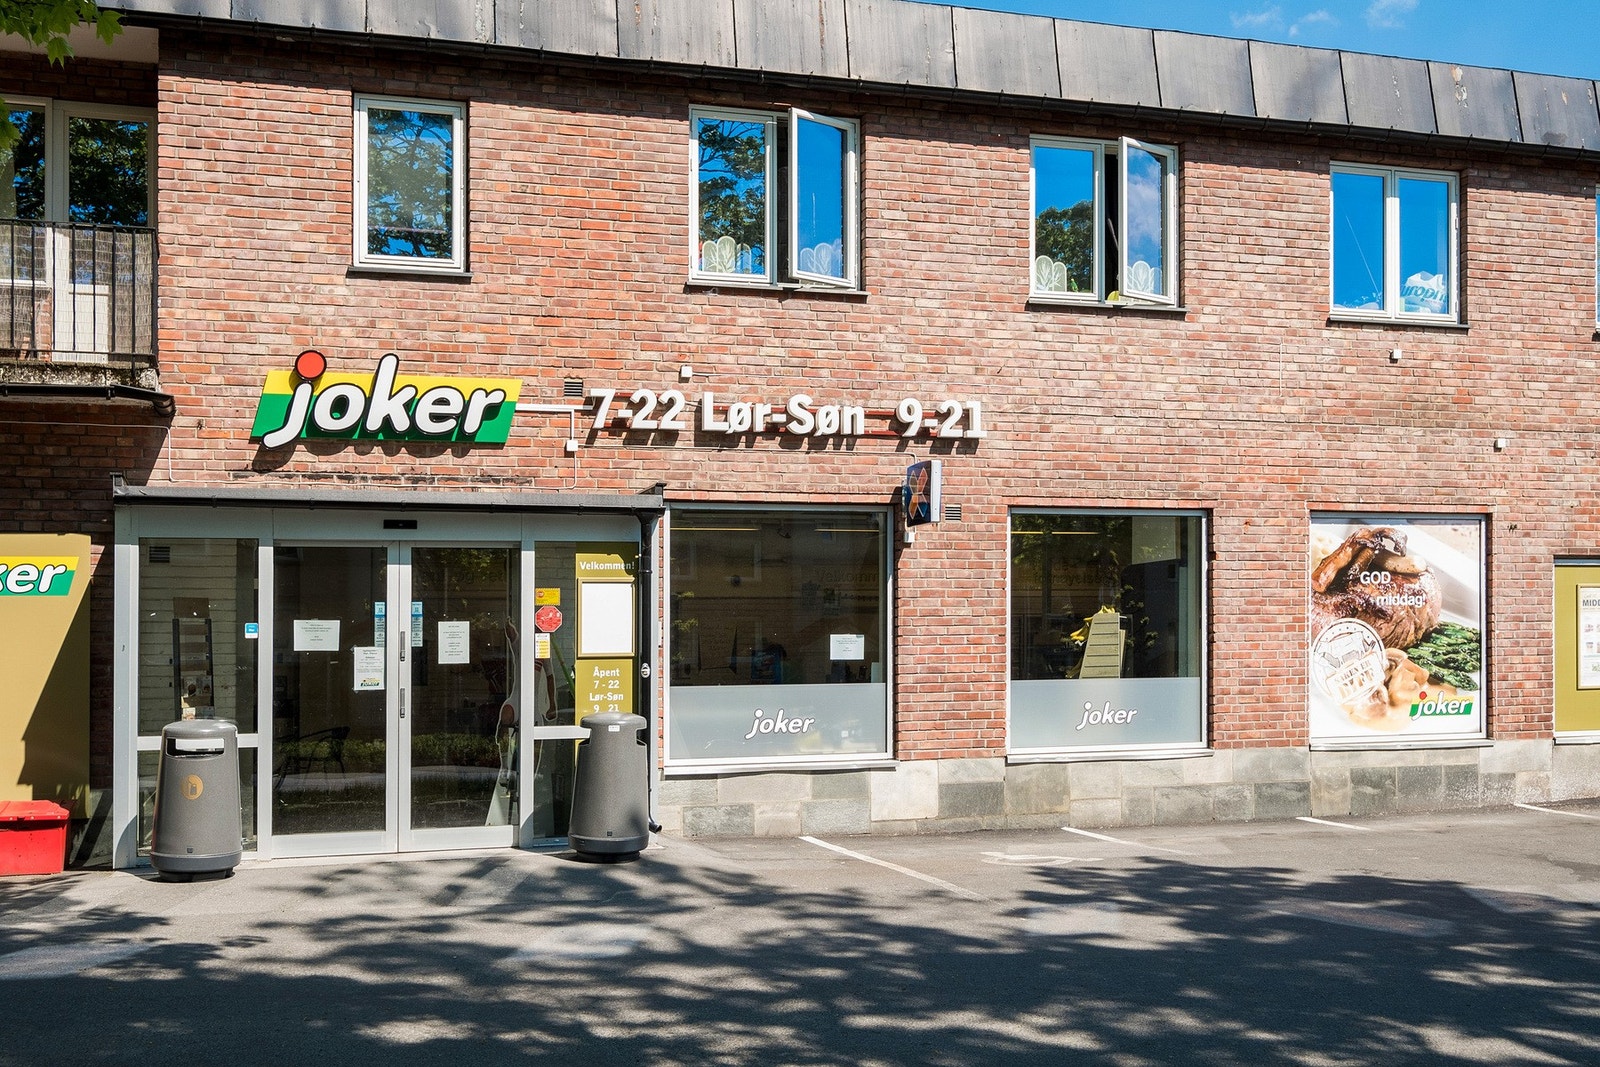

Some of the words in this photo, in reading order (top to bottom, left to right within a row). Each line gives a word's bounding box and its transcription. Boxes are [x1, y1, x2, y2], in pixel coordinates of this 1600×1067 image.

[261, 350, 507, 449] joker
[588, 388, 686, 430] 7-22
[701, 391, 865, 436] Lør-Søn
[897, 397, 987, 439] 9-21
[580, 561, 635, 570] Velkommen!
[0, 563, 68, 594] er
[1360, 571, 1391, 584] GOD
[1376, 593, 1426, 607] middag!
[593, 665, 620, 679] Åpent
[593, 680, 599, 689] 7
[608, 680, 620, 689] 22
[589, 692, 624, 701] Lør-Søn
[608, 704, 619, 712] 21
[1411, 691, 1470, 721] joker
[1075, 701, 1138, 731] joker
[744, 708, 815, 740] joker
